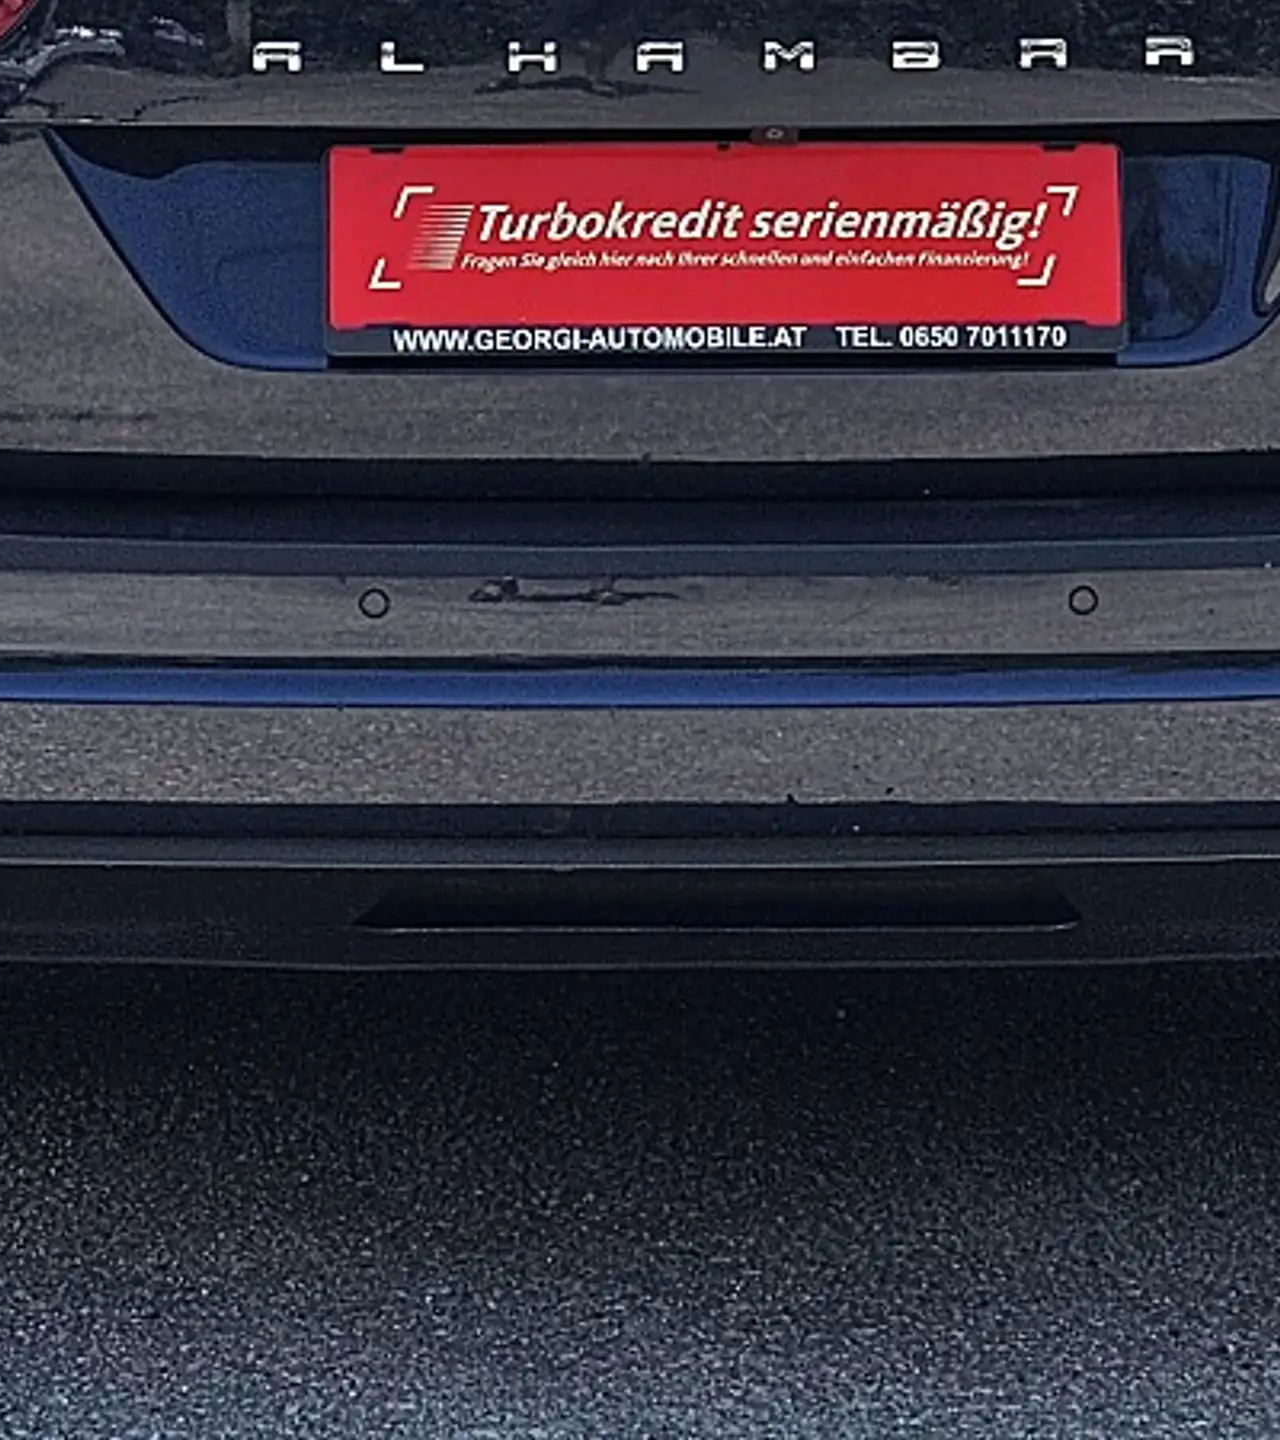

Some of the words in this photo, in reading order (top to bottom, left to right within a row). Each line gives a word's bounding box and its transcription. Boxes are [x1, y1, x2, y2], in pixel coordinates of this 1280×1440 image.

[251, 36, 1197, 77] ALHAMBRA
[478, 200, 743, 242] Turbokredit
[748, 200, 1049, 251] serienmäßig!
[460, 251, 517, 273] Fragen
[544, 250, 597, 271] gleich
[598, 250, 632, 267] hier
[634, 250, 674, 267] nach
[720, 250, 798, 267] schnellen
[800, 250, 833, 267] und
[835, 250, 914, 267] einfachen
[918, 250, 1030, 271] Finanzierung!
[392, 326, 808, 352] WWW.GEORGI-AUTOMOBILE.AT
[835, 326, 893, 347] TEL.
[899, 326, 959, 347] 0650
[967, 326, 1067, 347] 7011170
